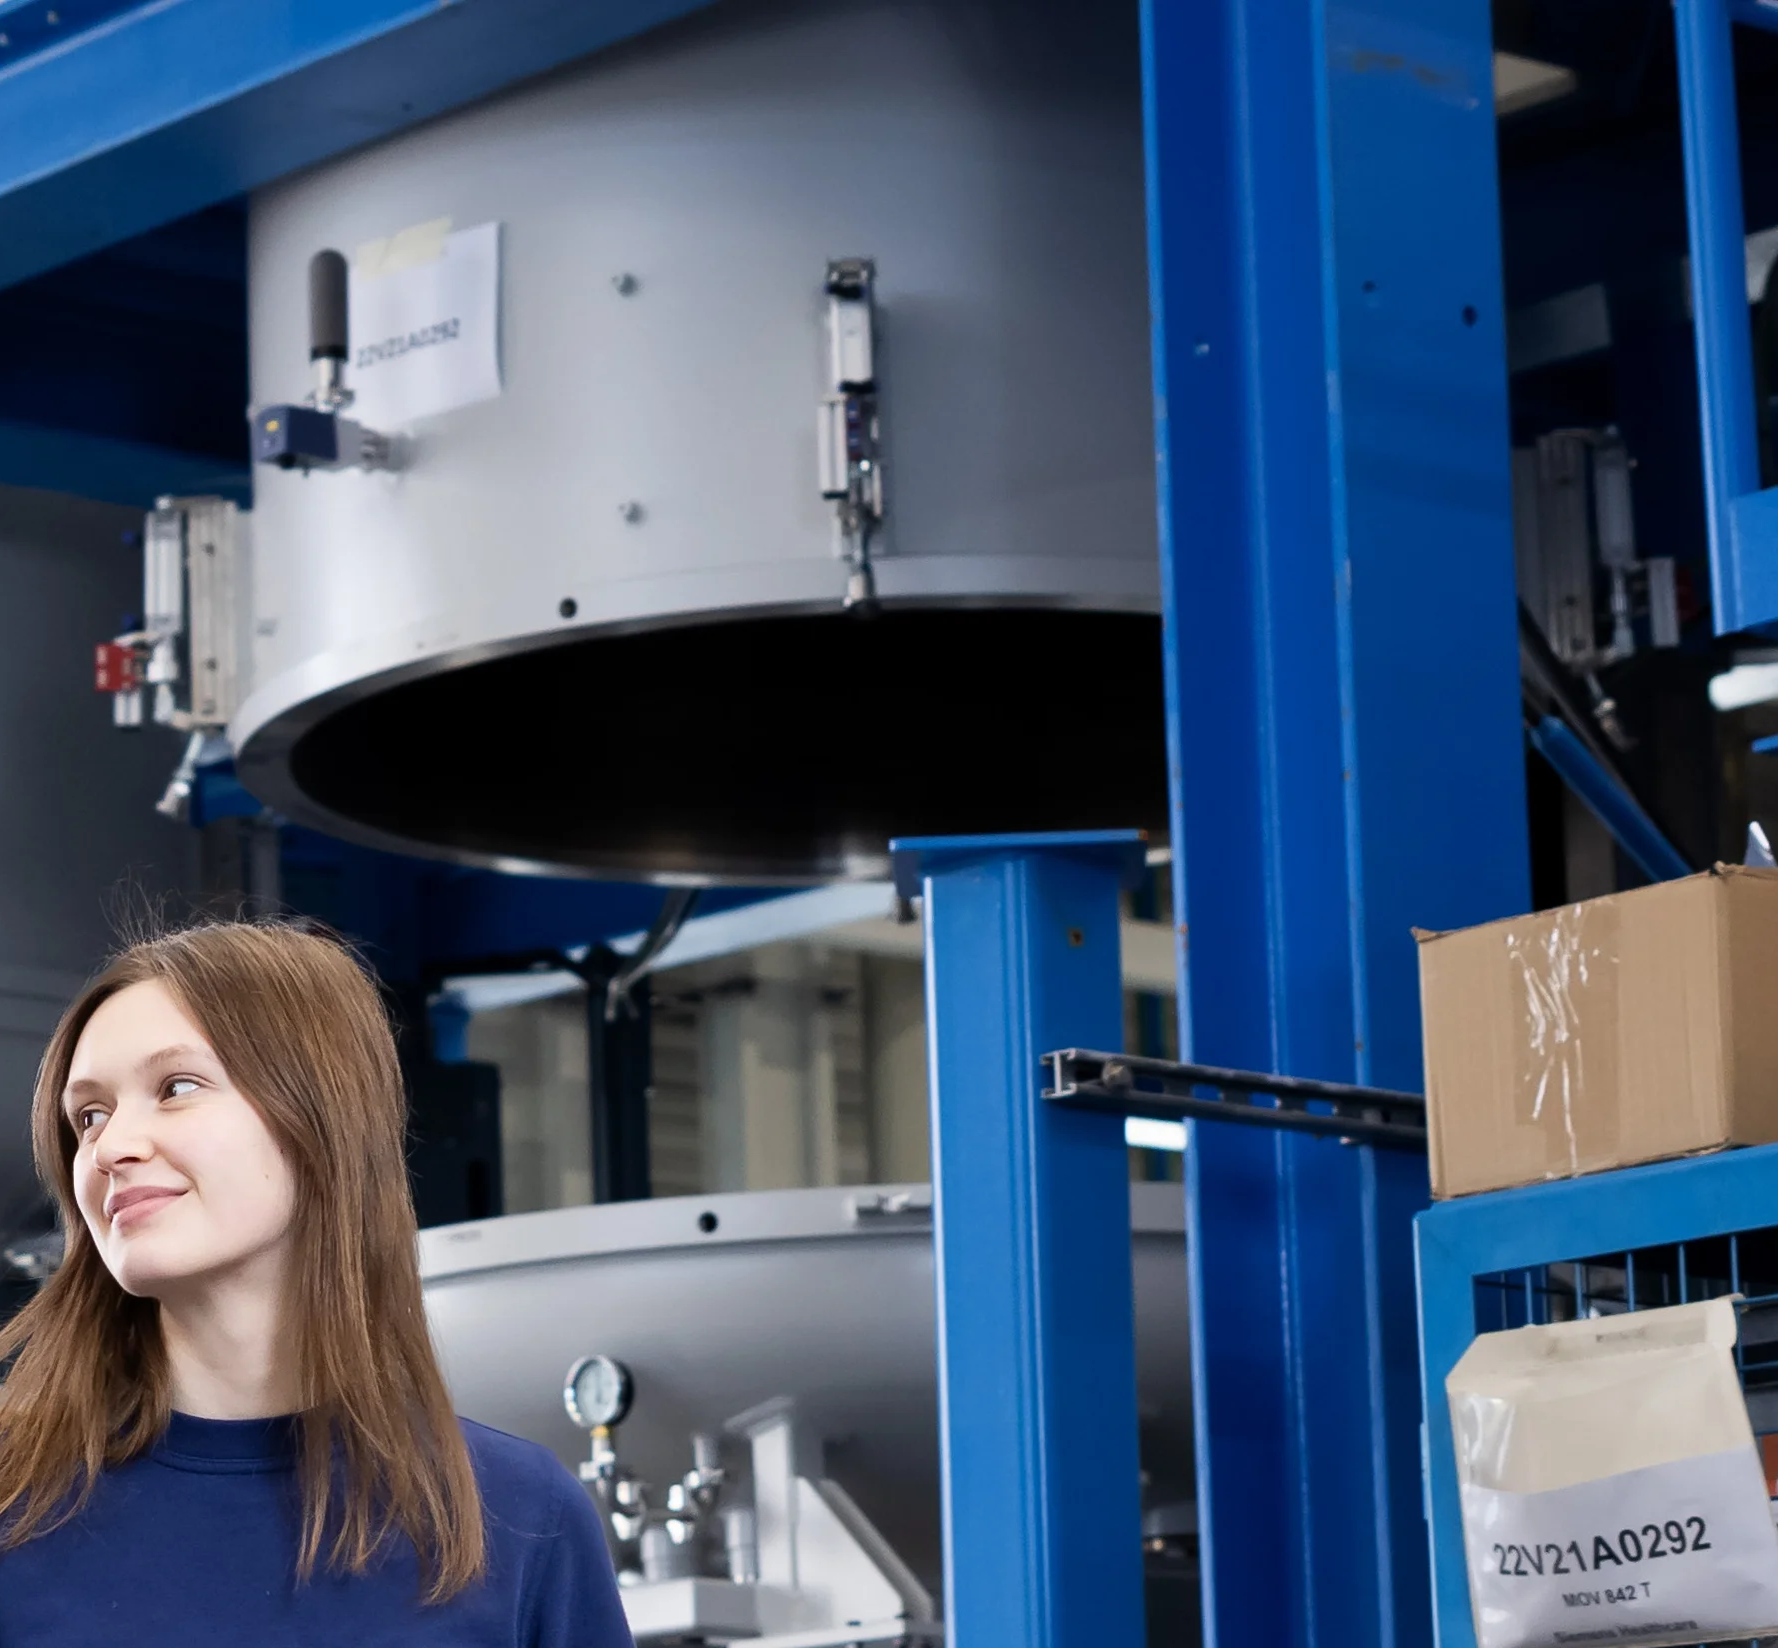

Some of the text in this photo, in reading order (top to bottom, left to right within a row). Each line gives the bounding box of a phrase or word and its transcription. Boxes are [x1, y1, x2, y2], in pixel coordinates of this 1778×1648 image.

[1493, 1516, 1712, 1576] 22V21A0292
[1562, 1582, 1652, 1608] MOV 842 T
